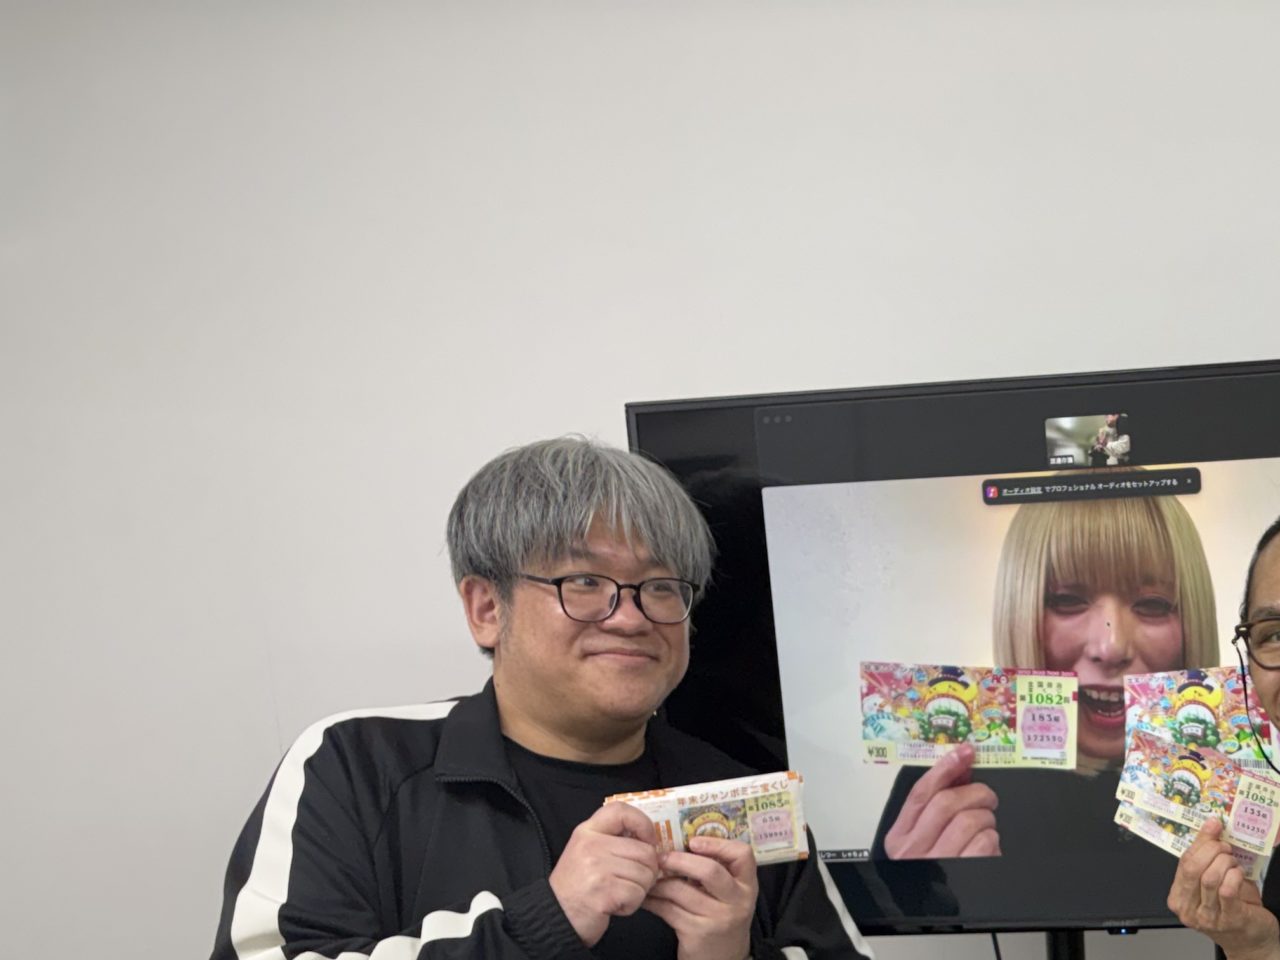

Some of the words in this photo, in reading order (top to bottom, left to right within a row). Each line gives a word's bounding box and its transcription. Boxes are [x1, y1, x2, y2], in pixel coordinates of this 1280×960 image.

[867, 746, 888, 758] ¥300
[677, 779, 789, 806] 年末ジャンボミニ宝くじ
